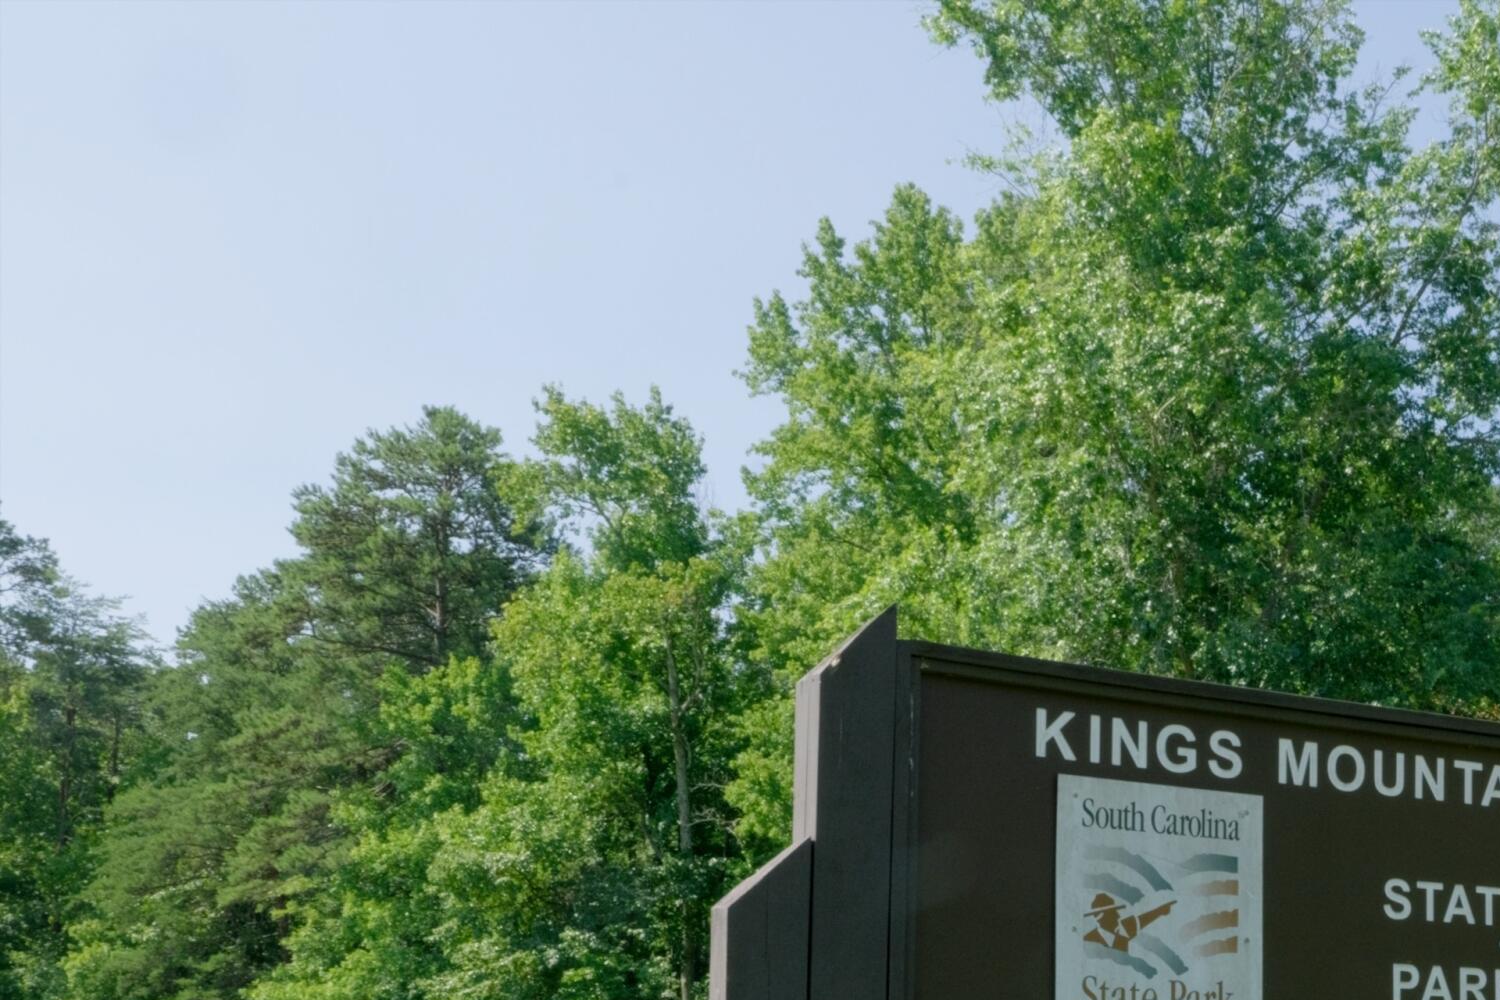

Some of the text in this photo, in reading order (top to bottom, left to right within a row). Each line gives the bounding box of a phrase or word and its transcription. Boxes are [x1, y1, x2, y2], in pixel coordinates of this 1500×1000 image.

[1035, 707, 1243, 780] KINGS
[1081, 797, 1241, 842] South Carolina
